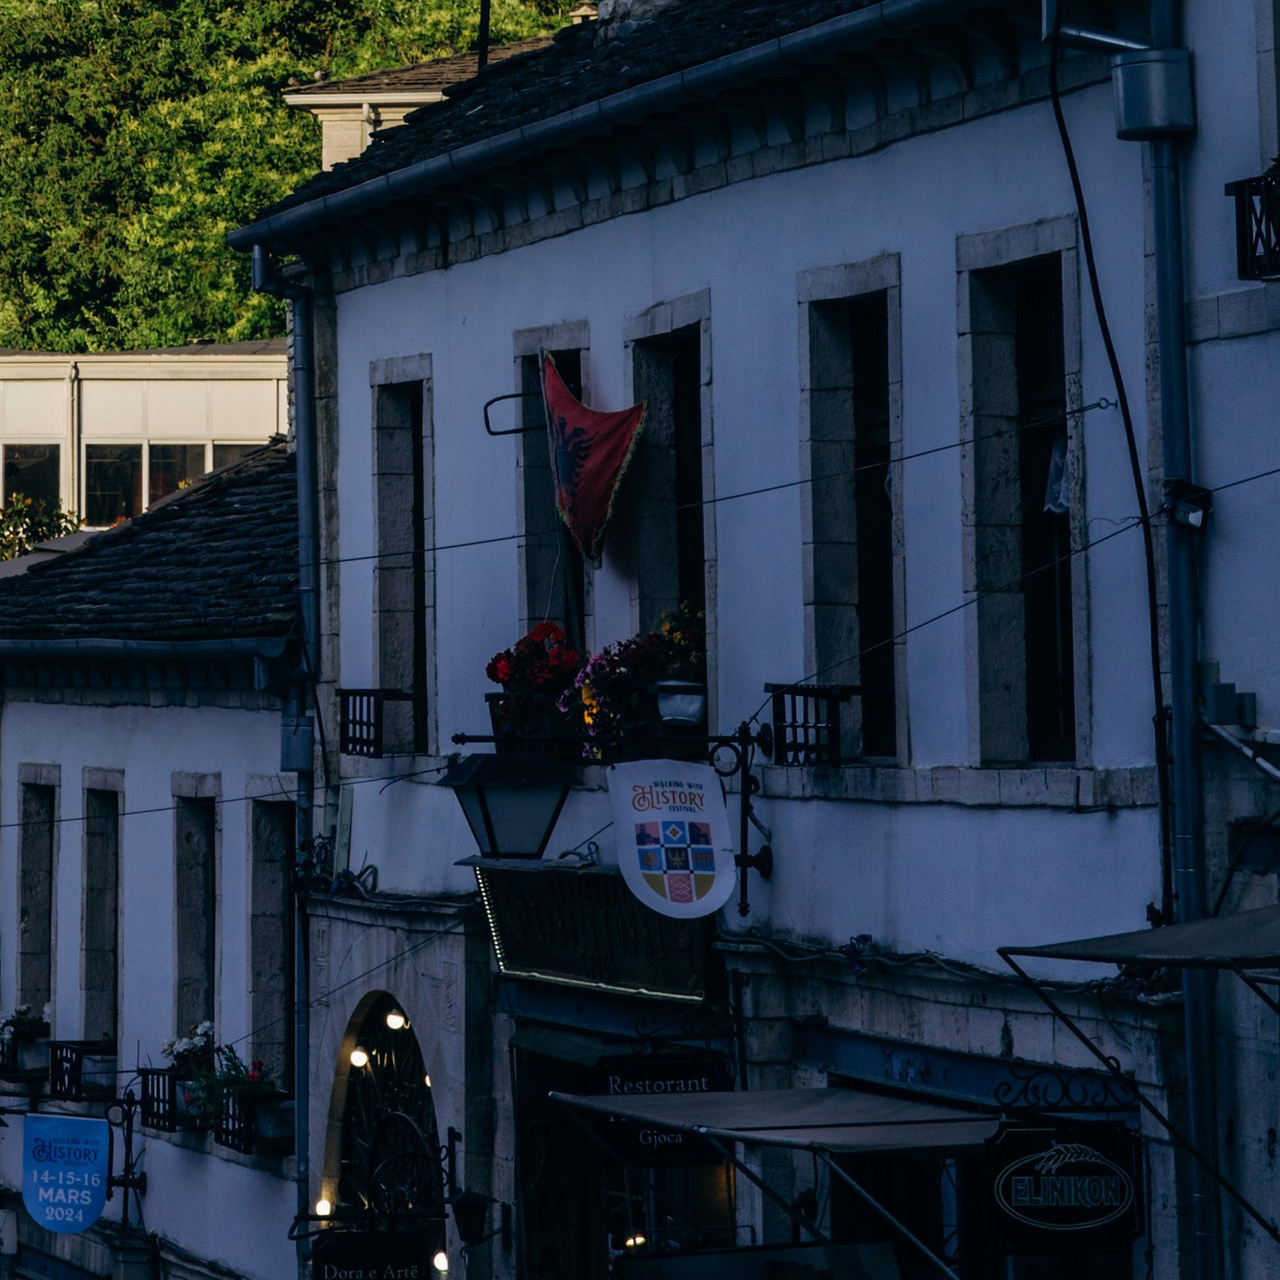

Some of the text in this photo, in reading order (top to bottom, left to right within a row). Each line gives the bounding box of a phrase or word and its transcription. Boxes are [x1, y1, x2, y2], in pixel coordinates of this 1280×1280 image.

[687, 782, 703, 790] WITH
[632, 785, 705, 812] HISTORY
[669, 805, 697, 813] FESTIVAL
[608, 1075, 709, 1094] Restorant
[639, 1129, 683, 1148] Gjoca
[32, 1137, 100, 1165] HISTORY
[32, 1169, 100, 1187] 14-15-16
[38, 1187, 92, 1205] MARS
[1011, 1176, 1121, 1208] ELINIKON
[45, 1206, 84, 1222] 2024
[324, 1264, 419, 1280] Dora e Artë
